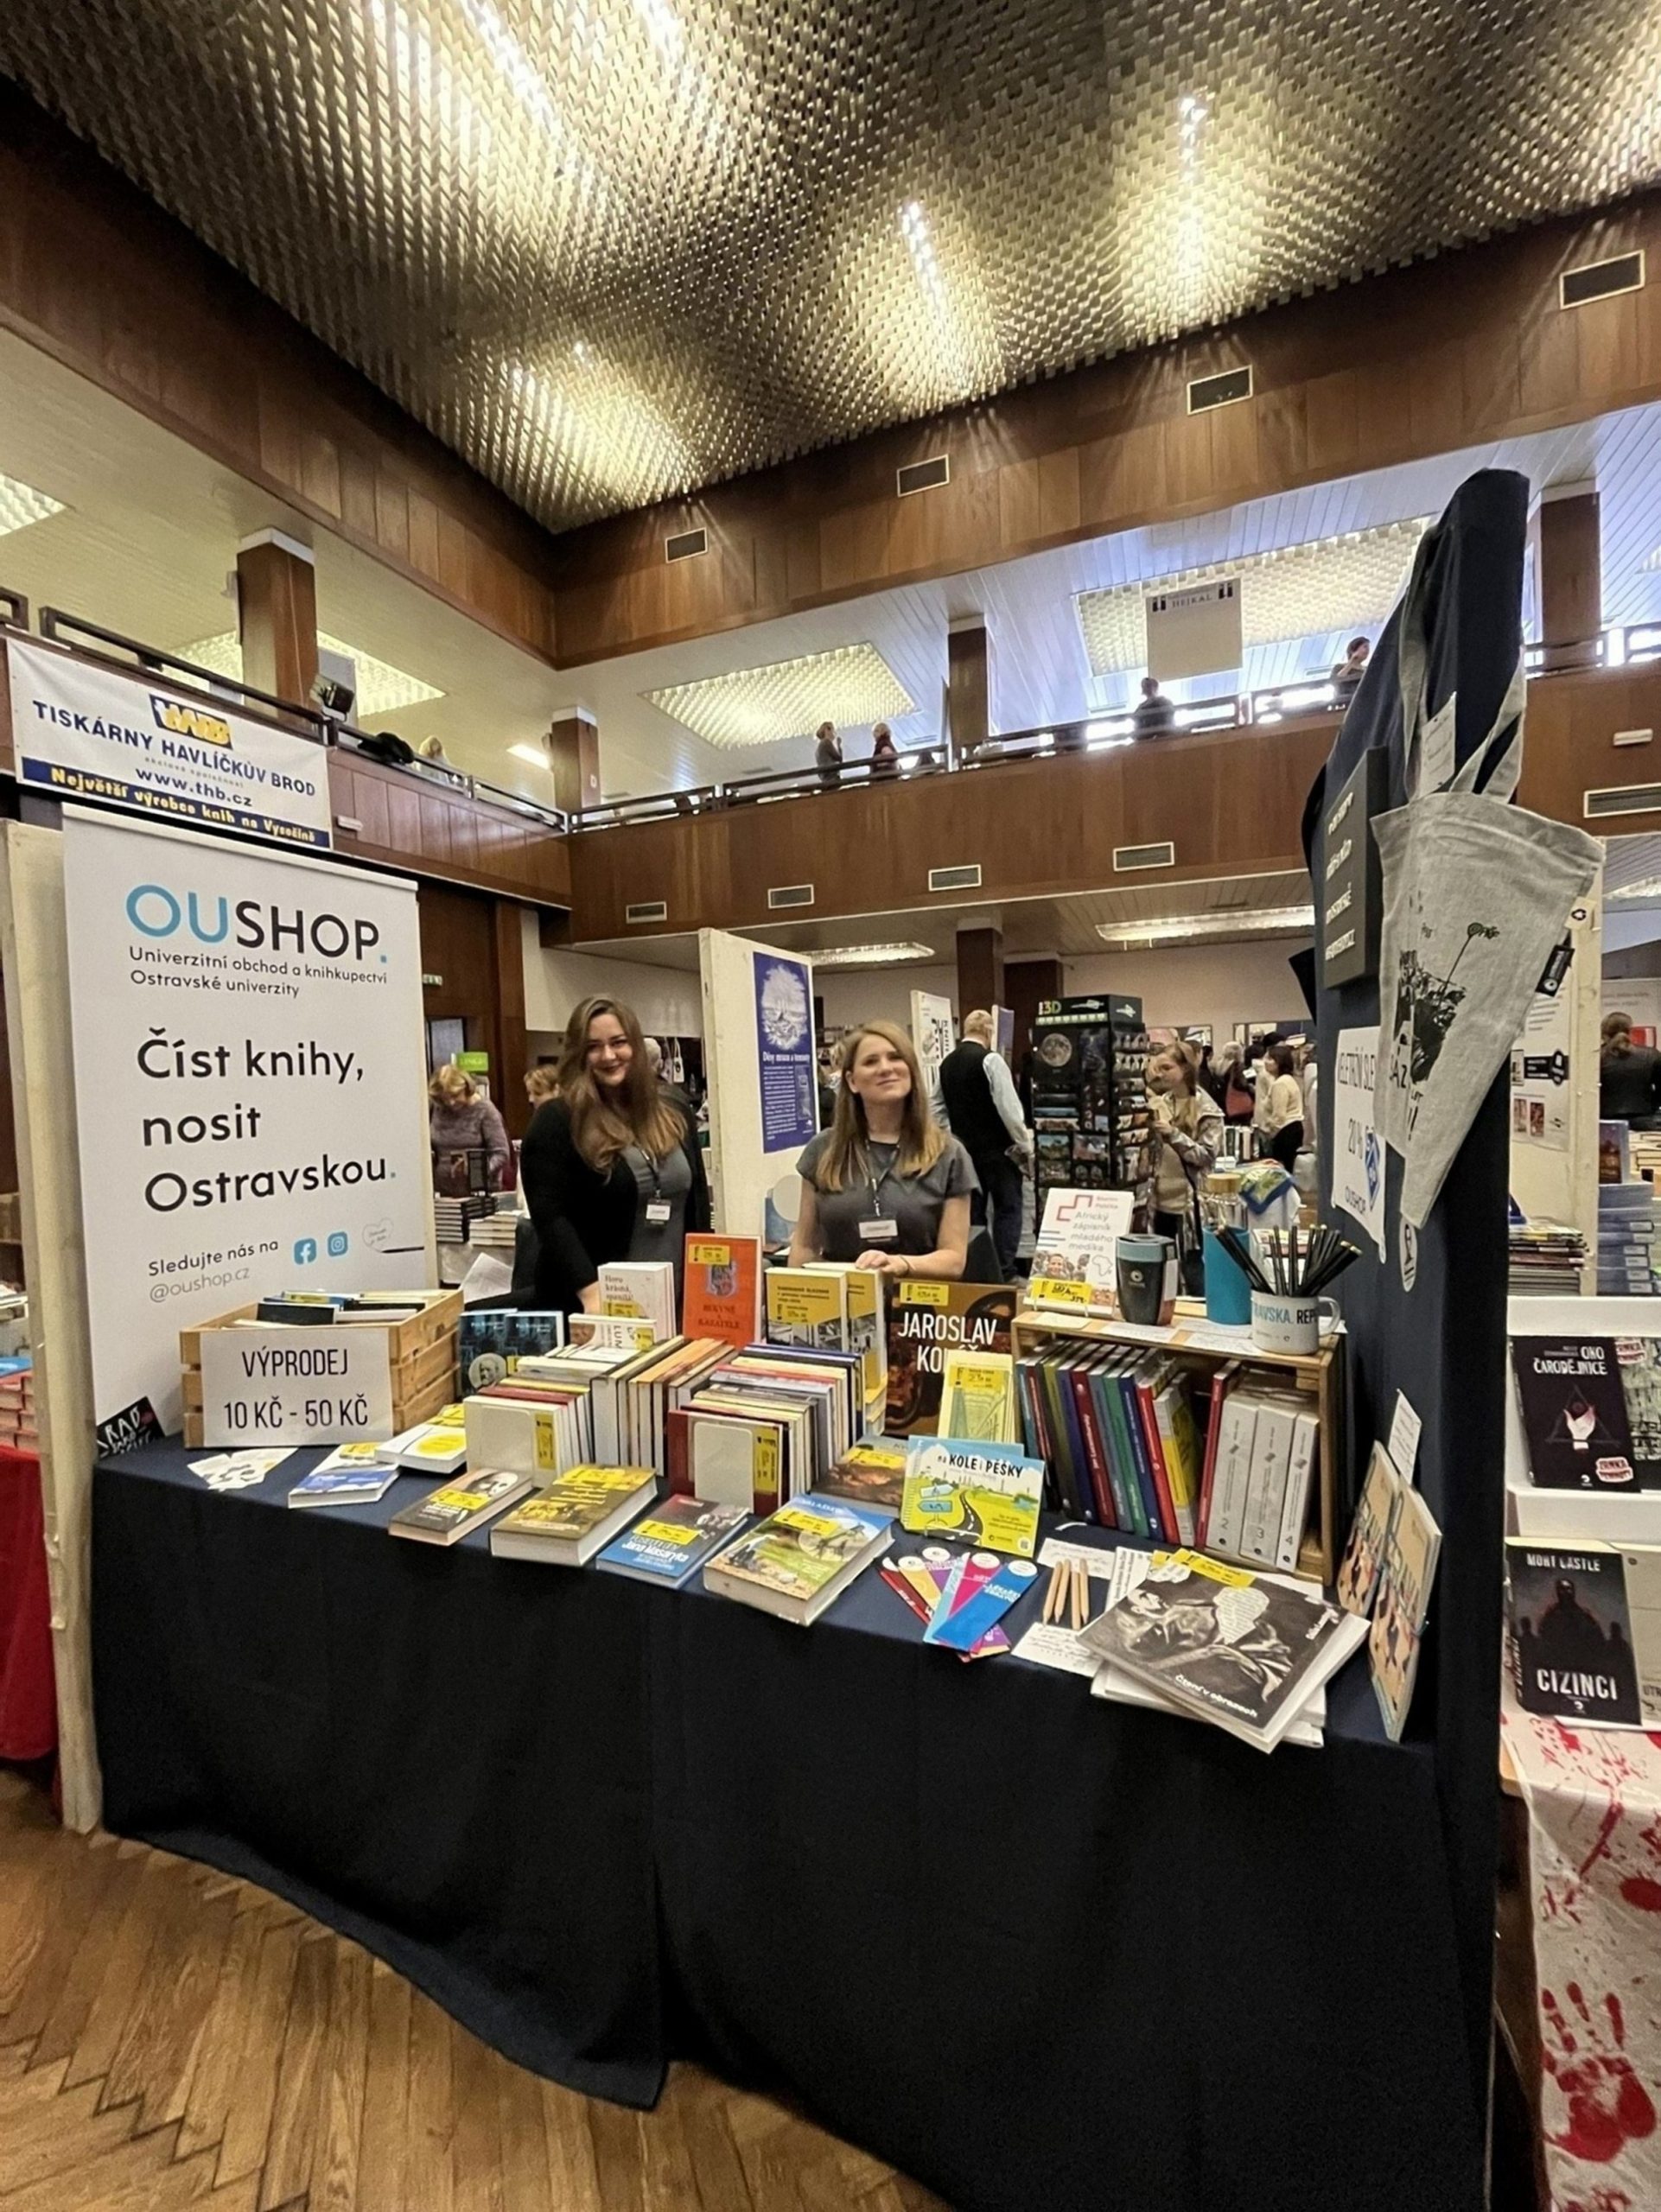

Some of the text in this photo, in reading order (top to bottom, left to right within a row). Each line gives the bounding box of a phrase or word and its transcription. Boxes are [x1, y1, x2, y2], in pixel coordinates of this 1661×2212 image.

[33, 700, 153, 750] TISKÁRNY
[271, 772, 315, 797] BROD
[51, 767, 129, 801] Největší
[134, 788, 196, 815] výrobce
[201, 803, 235, 824] knih
[242, 816, 258, 830] na
[136, 768, 252, 807] www.thb.cz
[129, 946, 387, 984] Univerzitní obchod a knihkupectví
[130, 970, 300, 999] Ostravské univerzity
[137, 1027, 363, 1084] Číst knihy,
[143, 1103, 262, 1146] nosit
[144, 1154, 396, 1211] Ostravskou.
[149, 1239, 278, 1276] Sledujte nás na
[150, 1268, 250, 1303] @oushop.cz
[897, 1312, 997, 1345] JAROSLAV
[242, 1345, 347, 1377] VÝPRODEJ
[1533, 1357, 1608, 1375] ČARODĚJNICE
[1581, 1345, 1605, 1360] OKO
[224, 1400, 247, 1428] 10
[254, 1396, 283, 1428] KČ
[305, 1399, 333, 1427] 50
[339, 1394, 368, 1426] KČ
[949, 1454, 977, 1469] KOLE
[985, 1459, 1023, 1478] PĚŠKY
[1220, 1518, 1228, 1529] 2
[1257, 1528, 1264, 1539] 3
[1285, 1535, 1294, 1546] 4
[1527, 1554, 1601, 1572] MORT CASTLE
[1175, 1674, 1204, 1692] Čtení
[1210, 1692, 1258, 1718] obrazech
[1537, 1669, 1618, 1700] CIZINCI
